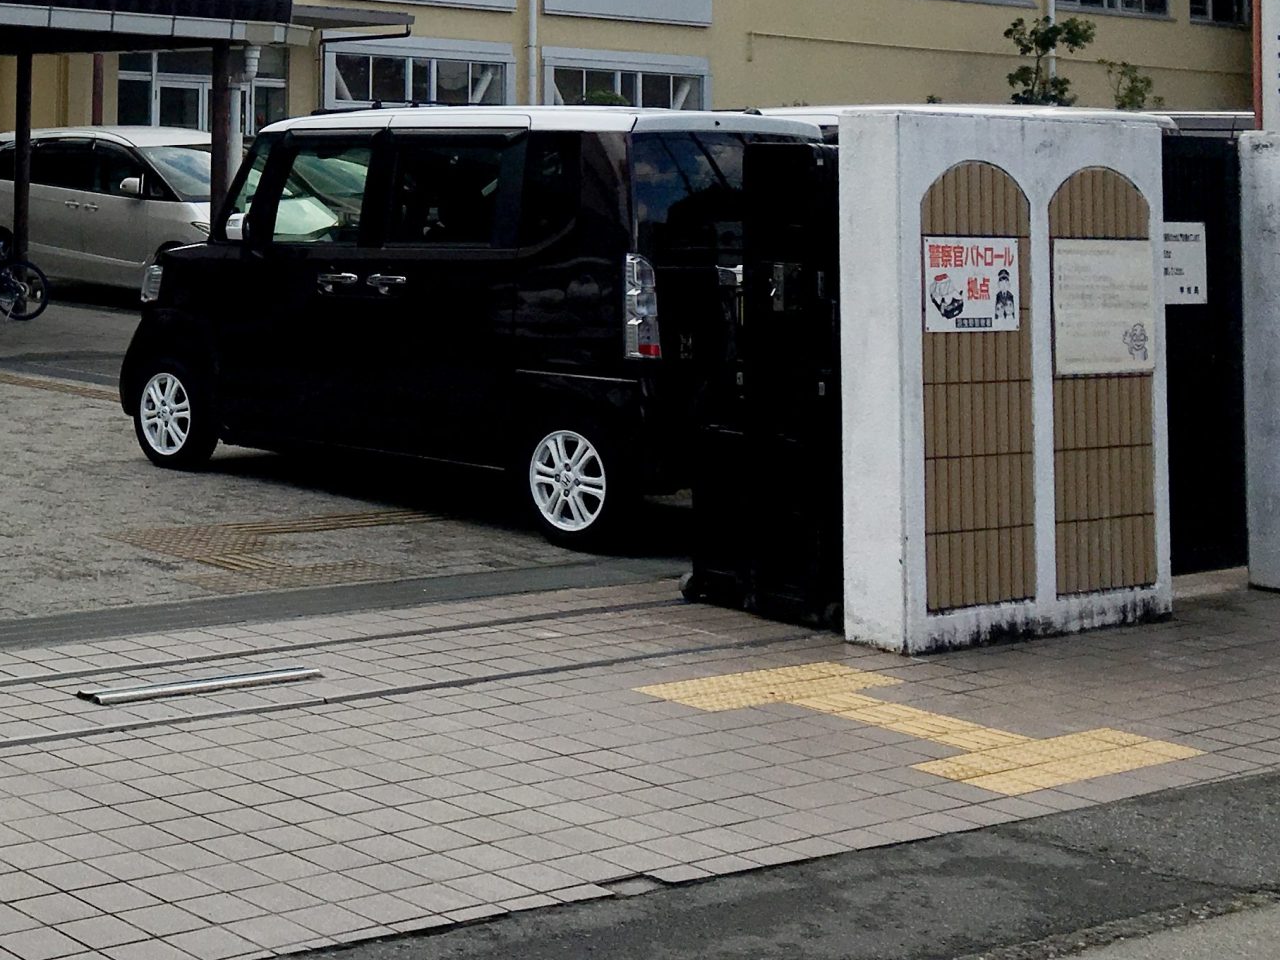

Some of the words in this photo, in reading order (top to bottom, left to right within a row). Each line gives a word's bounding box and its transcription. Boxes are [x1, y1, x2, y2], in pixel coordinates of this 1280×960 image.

[929, 244, 1014, 268] 警察官パトロール
[967, 277, 990, 300] 拠点
